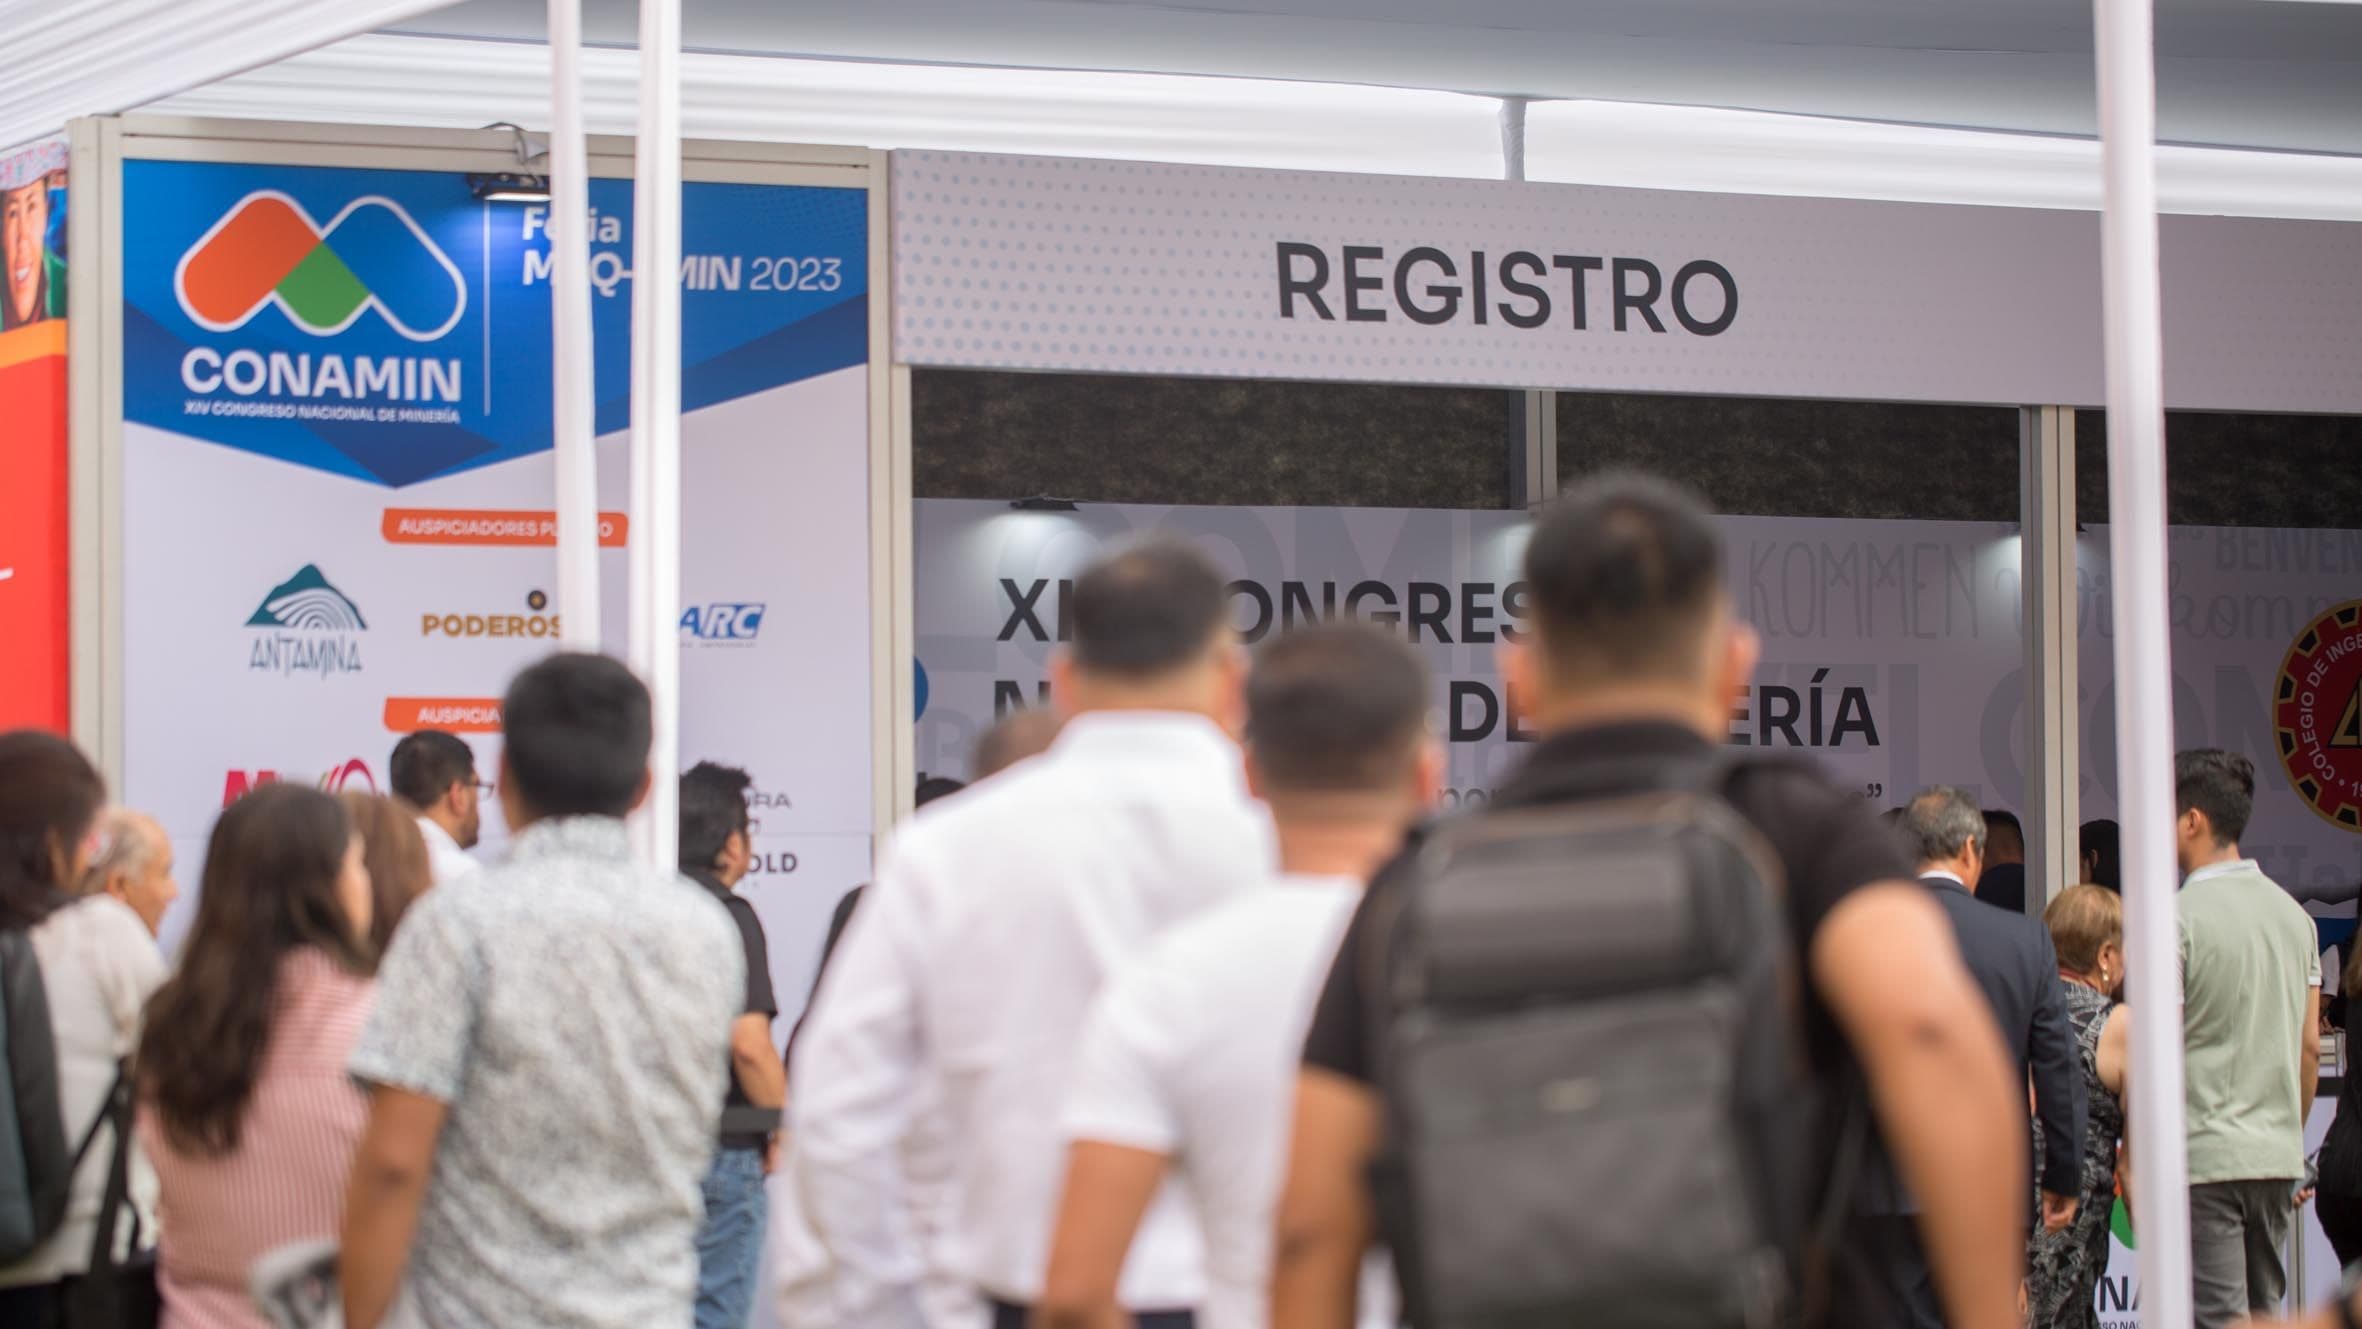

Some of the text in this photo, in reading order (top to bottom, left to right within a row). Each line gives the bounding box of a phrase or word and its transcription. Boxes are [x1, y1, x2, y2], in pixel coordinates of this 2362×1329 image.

[523, 211, 621, 243] Fia
[750, 256, 842, 291] 2023
[1276, 241, 1739, 337] REGISTRO
[181, 346, 461, 402] CONAMIN
[184, 400, 461, 425] XIV CONGRESO NACIONAL DE MINERÍA
[398, 515, 538, 538] AUSPICIADORES
[422, 614, 561, 637] PODEROS
[996, 578, 1530, 645] XI ONGRES
[249, 632, 363, 680] ANTAMINA
[2306, 657, 2330, 688] DE
[416, 706, 502, 725] AUSPICIA
[1722, 667, 1881, 747] ERÍA
[2300, 691, 2337, 782] COLEGIO
[747, 853, 799, 874] OLD
